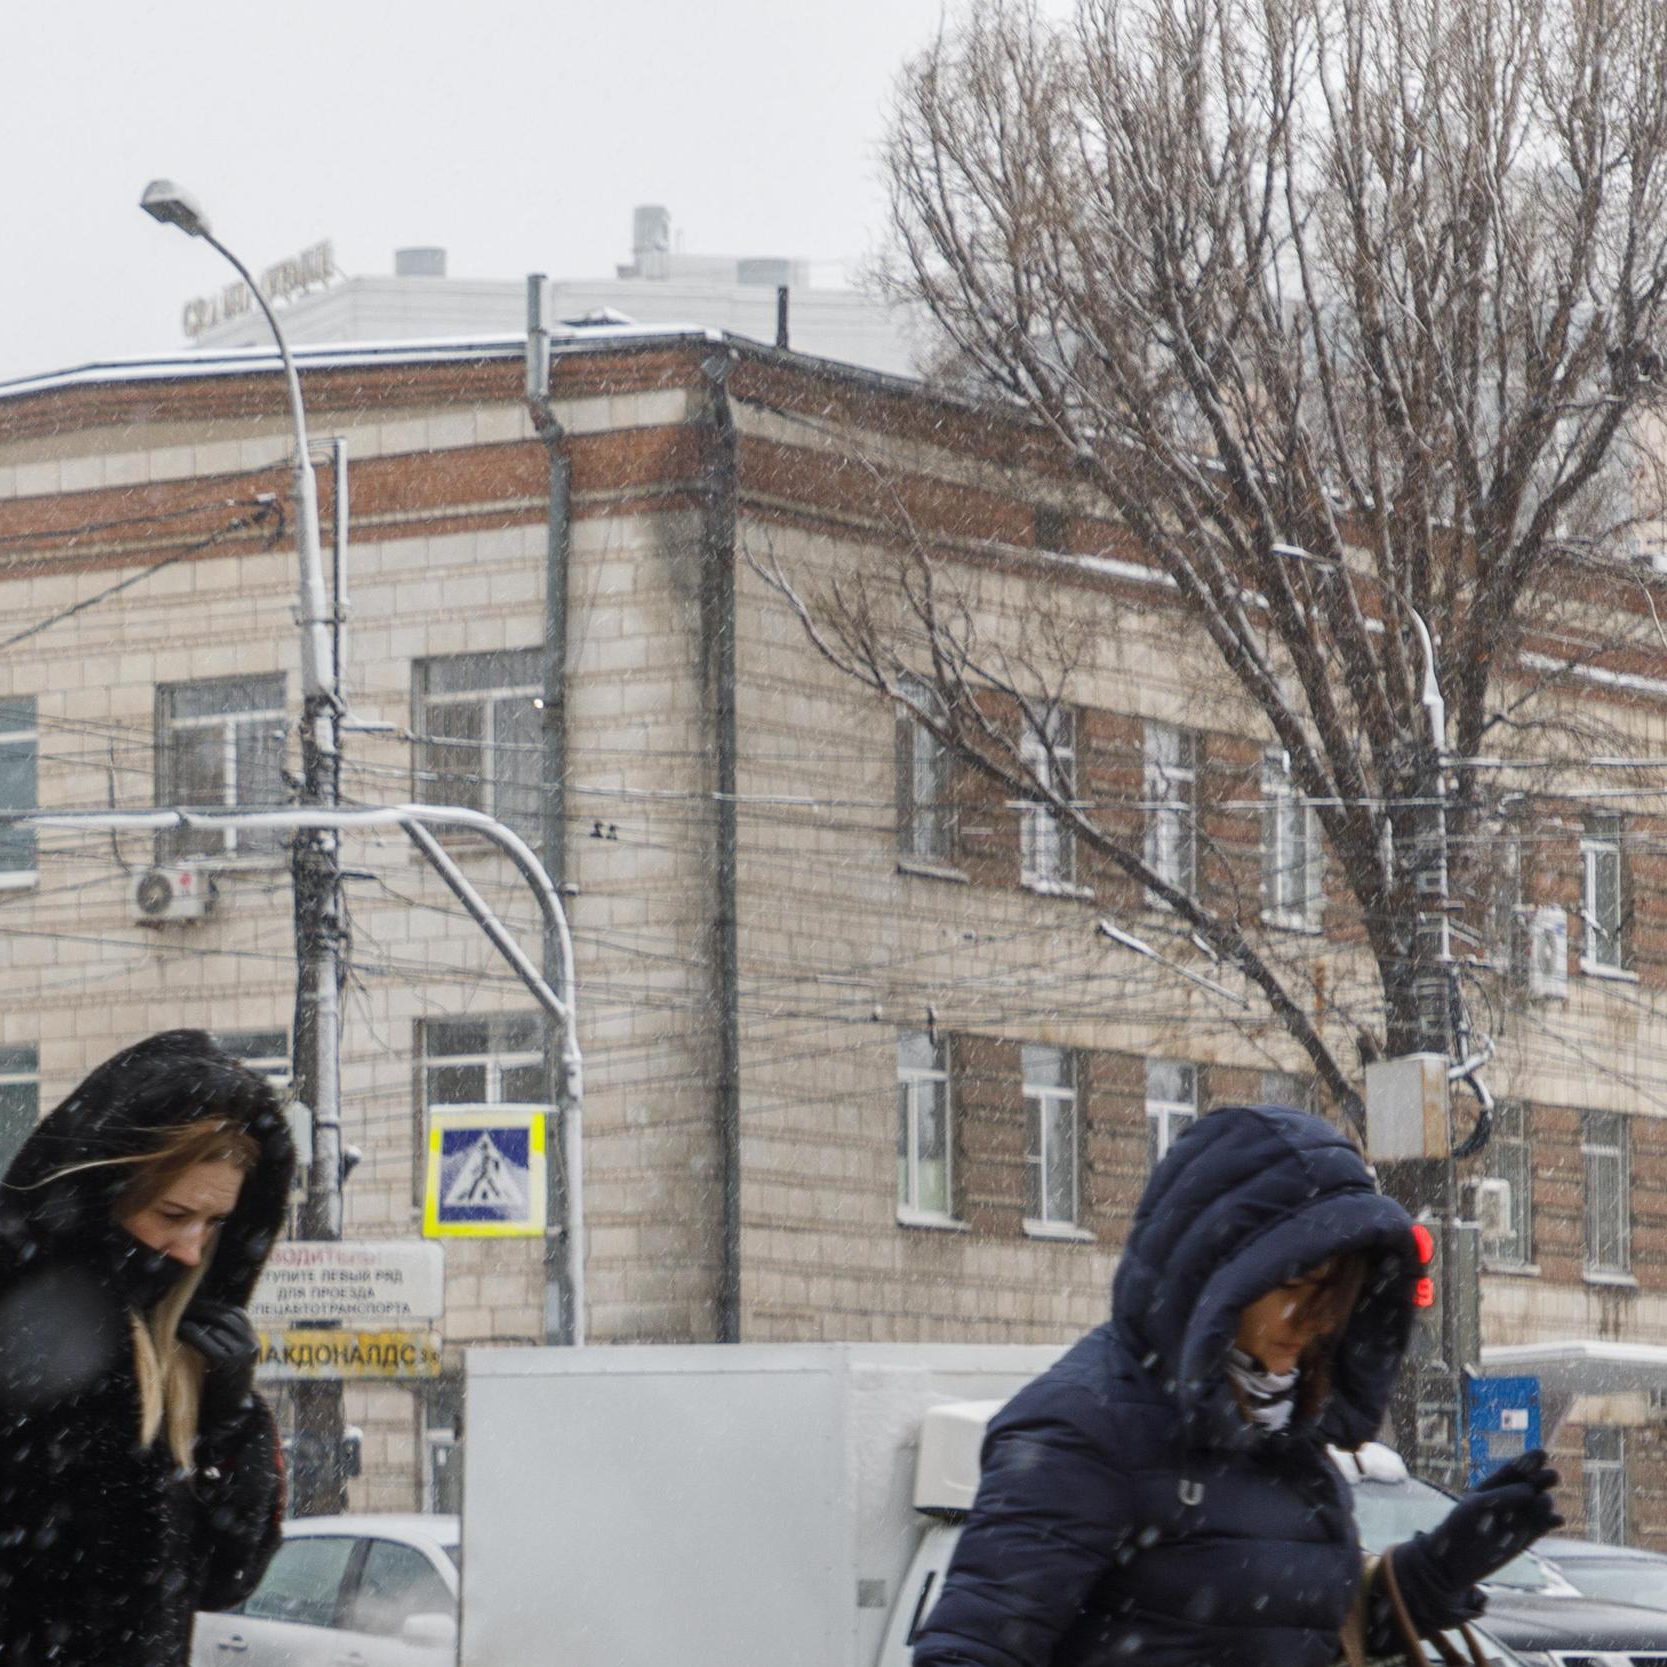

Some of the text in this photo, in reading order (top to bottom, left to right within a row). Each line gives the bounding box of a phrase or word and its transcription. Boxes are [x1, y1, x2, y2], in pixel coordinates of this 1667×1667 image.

[263, 1268, 403, 1285] ТУПИТЕ ЛЕВЫЙ РЯД
[277, 1286, 376, 1302] ДЛЯ ПРОЕЗДА
